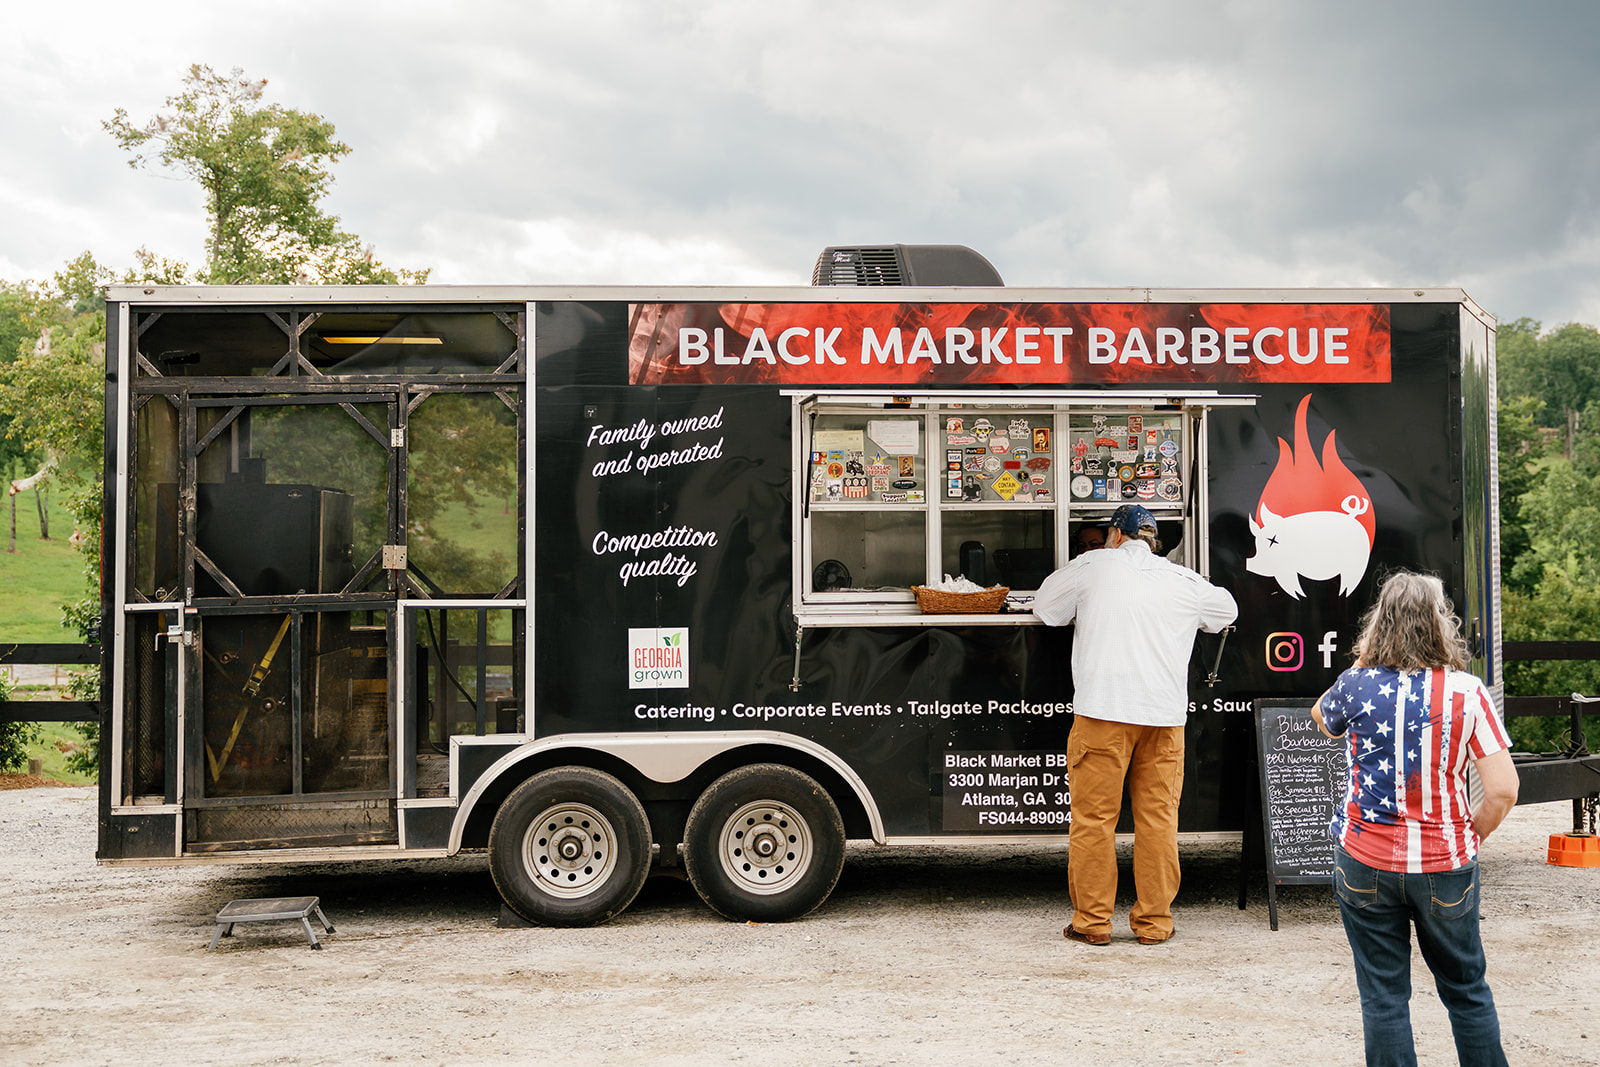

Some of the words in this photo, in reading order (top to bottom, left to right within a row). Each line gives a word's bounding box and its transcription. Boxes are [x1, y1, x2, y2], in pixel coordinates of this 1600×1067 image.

[679, 327, 846, 365] BLACK
[861, 328, 1073, 364] MARKET
[1089, 327, 1349, 364] BARBECUE
[587, 418, 656, 450] Family
[661, 406, 724, 436] owned
[592, 450, 633, 478] and
[636, 436, 724, 476] operated
[592, 525, 718, 556] Competition
[619, 552, 697, 587] quality
[634, 648, 682, 668] GEORGIA
[634, 670, 682, 682] grown
[634, 703, 715, 722] Catering
[732, 703, 826, 721] Corporate
[832, 702, 892, 716] Events
[908, 701, 982, 718] Tailgate
[988, 700, 1074, 716] Packages
[1277, 714, 1312, 734] Black
[1277, 734, 1338, 750] Barbecue
[945, 754, 987, 768] Black
[991, 754, 1041, 768] Market
[1266, 753, 1285, 764] BBQ
[1288, 754, 1312, 764] Nachos
[948, 774, 984, 786] 3300
[988, 773, 1038, 789] Marjan
[1042, 774, 1060, 786] Dr
[962, 792, 1018, 807] Atlanta,
[1022, 792, 1047, 806] GA
[1054, 792, 1072, 805] 30
[1268, 786, 1283, 797] Pork
[979, 812, 1072, 824] FS044-89094
[1284, 806, 1312, 814] Special
[1272, 830, 1288, 839] Mac
[1274, 846, 1302, 856] Brisket
